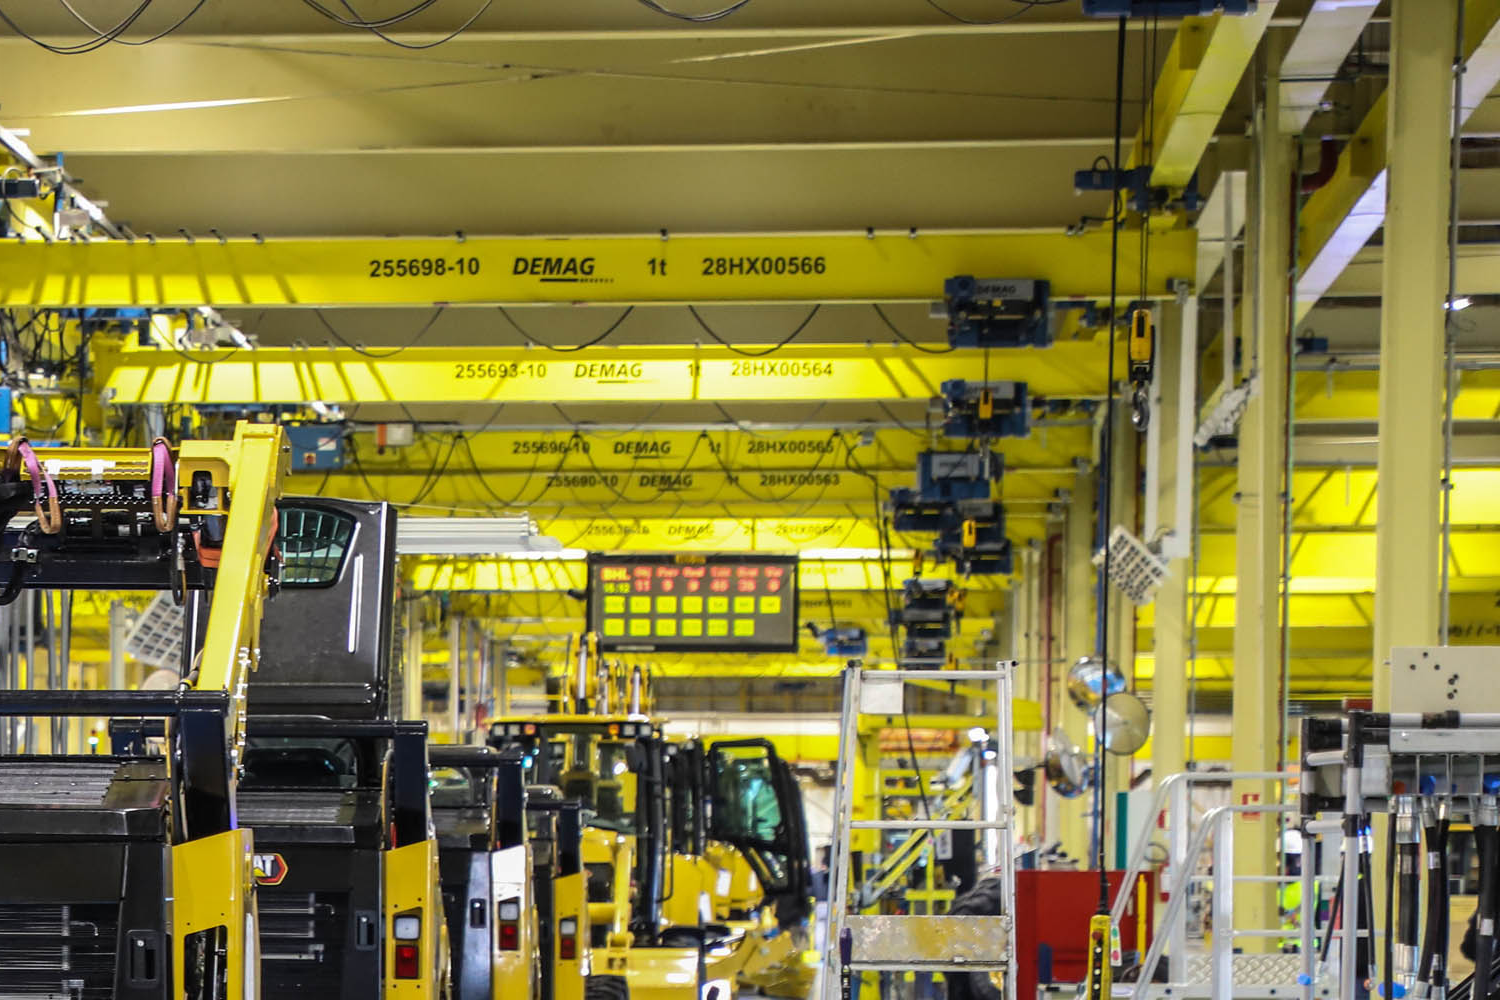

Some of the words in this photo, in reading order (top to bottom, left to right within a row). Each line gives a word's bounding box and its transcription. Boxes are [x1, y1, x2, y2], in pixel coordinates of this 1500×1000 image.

[369, 258, 480, 278] 255698-10
[512, 257, 596, 276] DEMAG
[647, 259, 667, 277] 1t
[702, 257, 827, 276] 28HX00566
[455, 363, 547, 379] 255693-10
[573, 363, 643, 378] DEMAG
[731, 361, 834, 378] 28HX00564
[613, 441, 672, 455] DEMAG
[639, 475, 694, 487] DEMAG
[254, 855, 275, 877] AT
